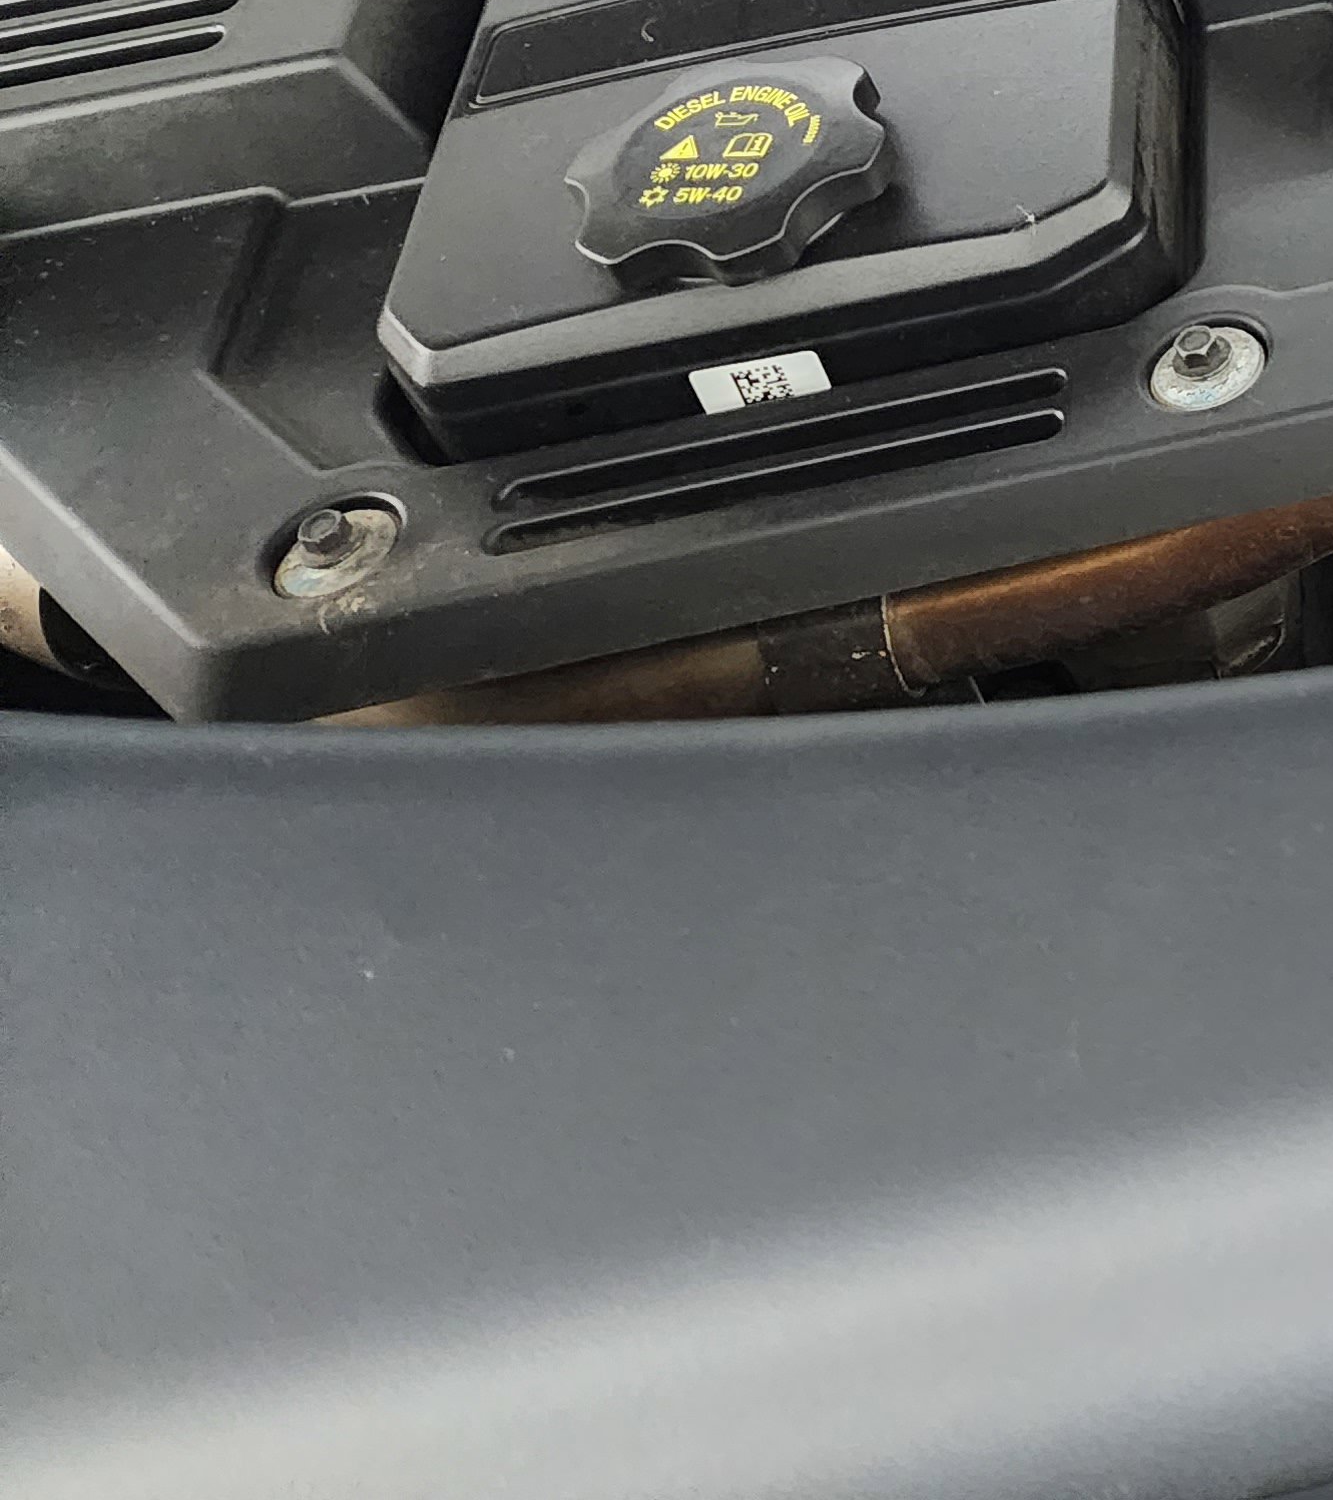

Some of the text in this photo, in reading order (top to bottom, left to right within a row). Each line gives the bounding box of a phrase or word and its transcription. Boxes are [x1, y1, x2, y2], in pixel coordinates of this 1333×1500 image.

[654, 84, 811, 132] DIESEL ENGINE OIL
[684, 162, 760, 181] 10W-30
[672, 185, 744, 203] 5W-40
